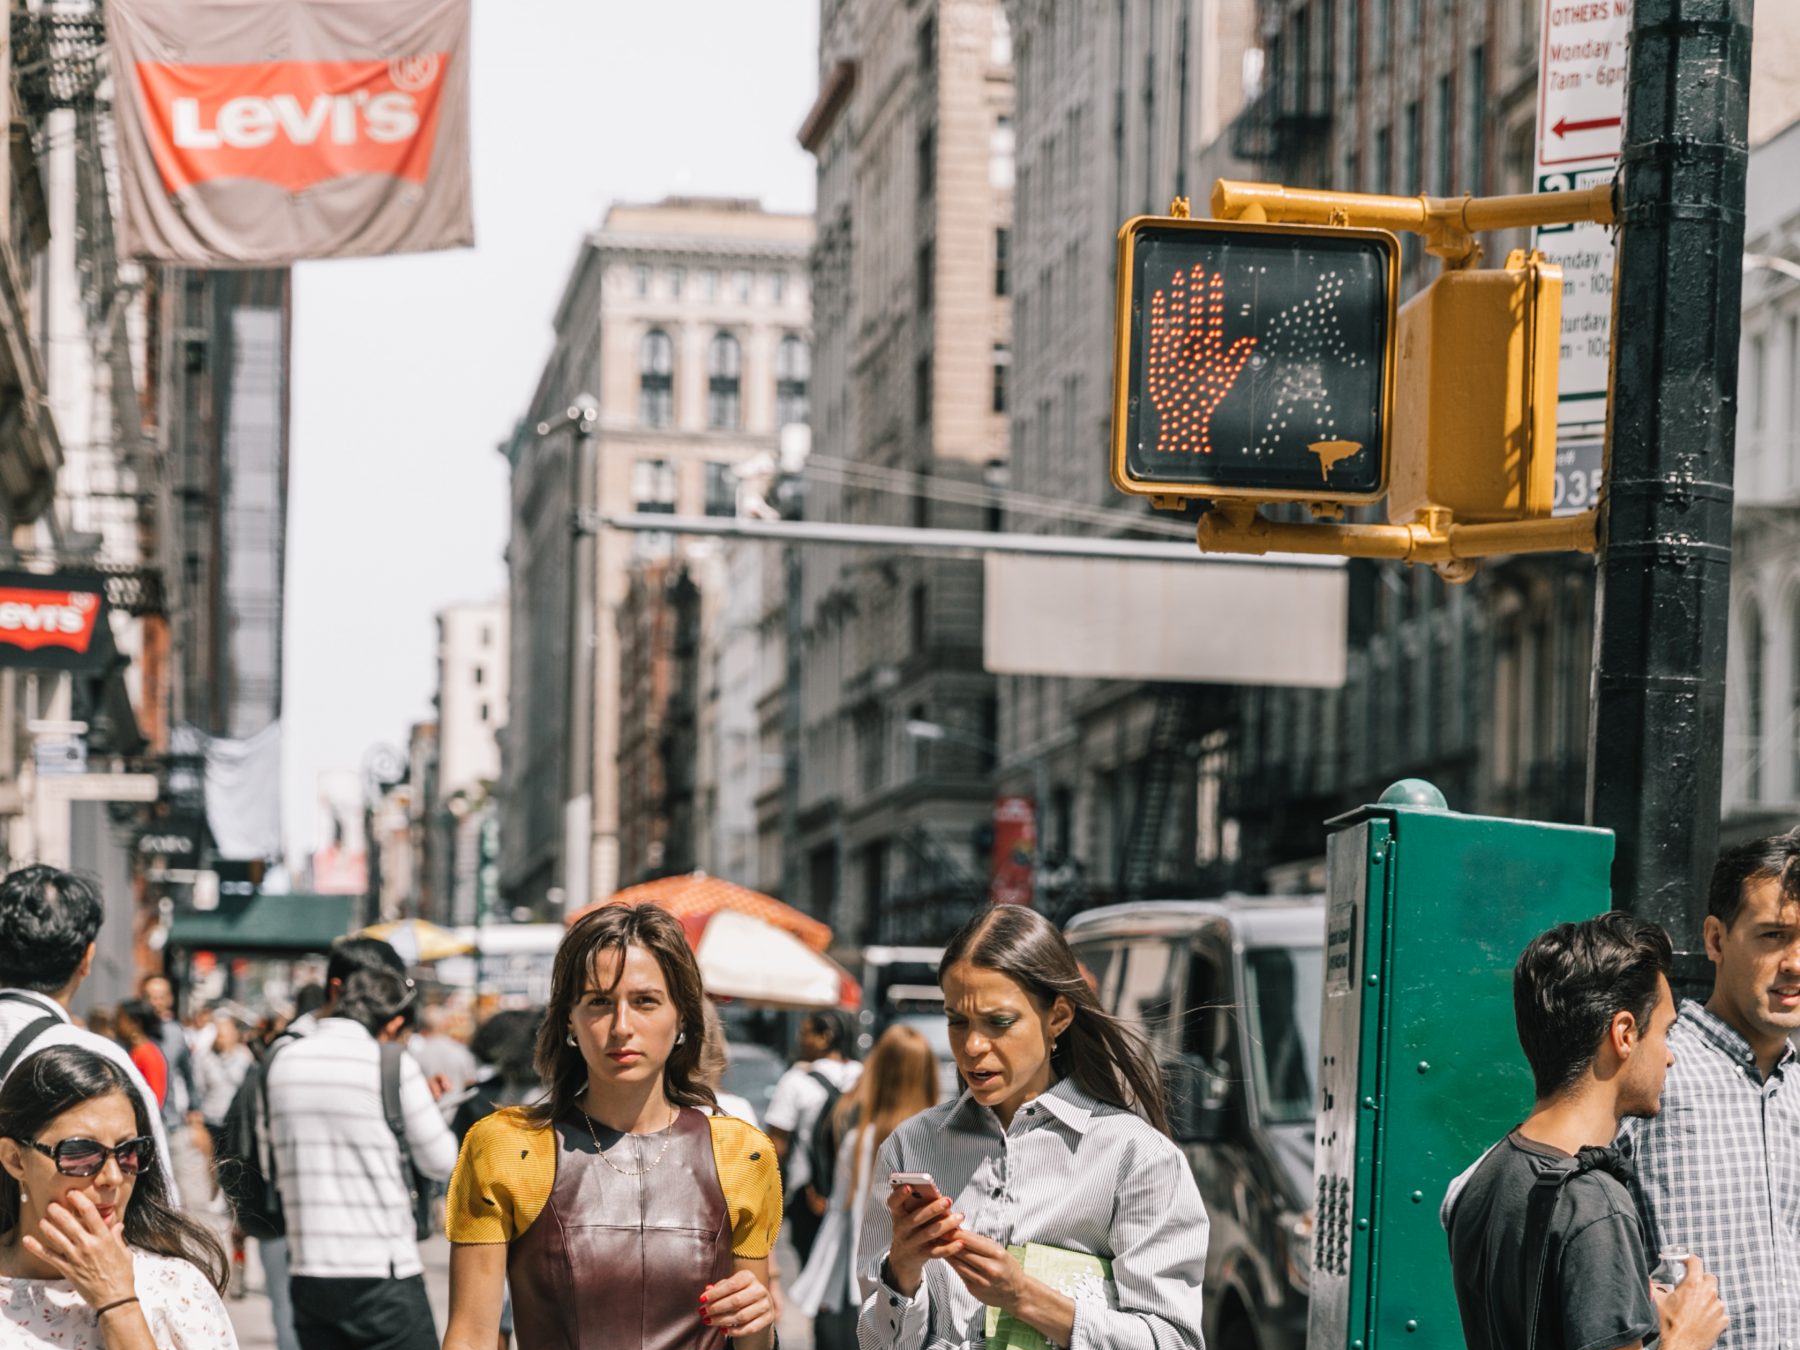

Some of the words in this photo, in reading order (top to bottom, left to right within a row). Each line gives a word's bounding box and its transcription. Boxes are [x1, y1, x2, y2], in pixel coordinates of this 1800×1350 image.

[1551, 2, 1609, 26] OTHERS
[1613, 1, 1628, 17] N
[1550, 40, 1612, 61] Monday
[1550, 69, 1582, 91] 7am
